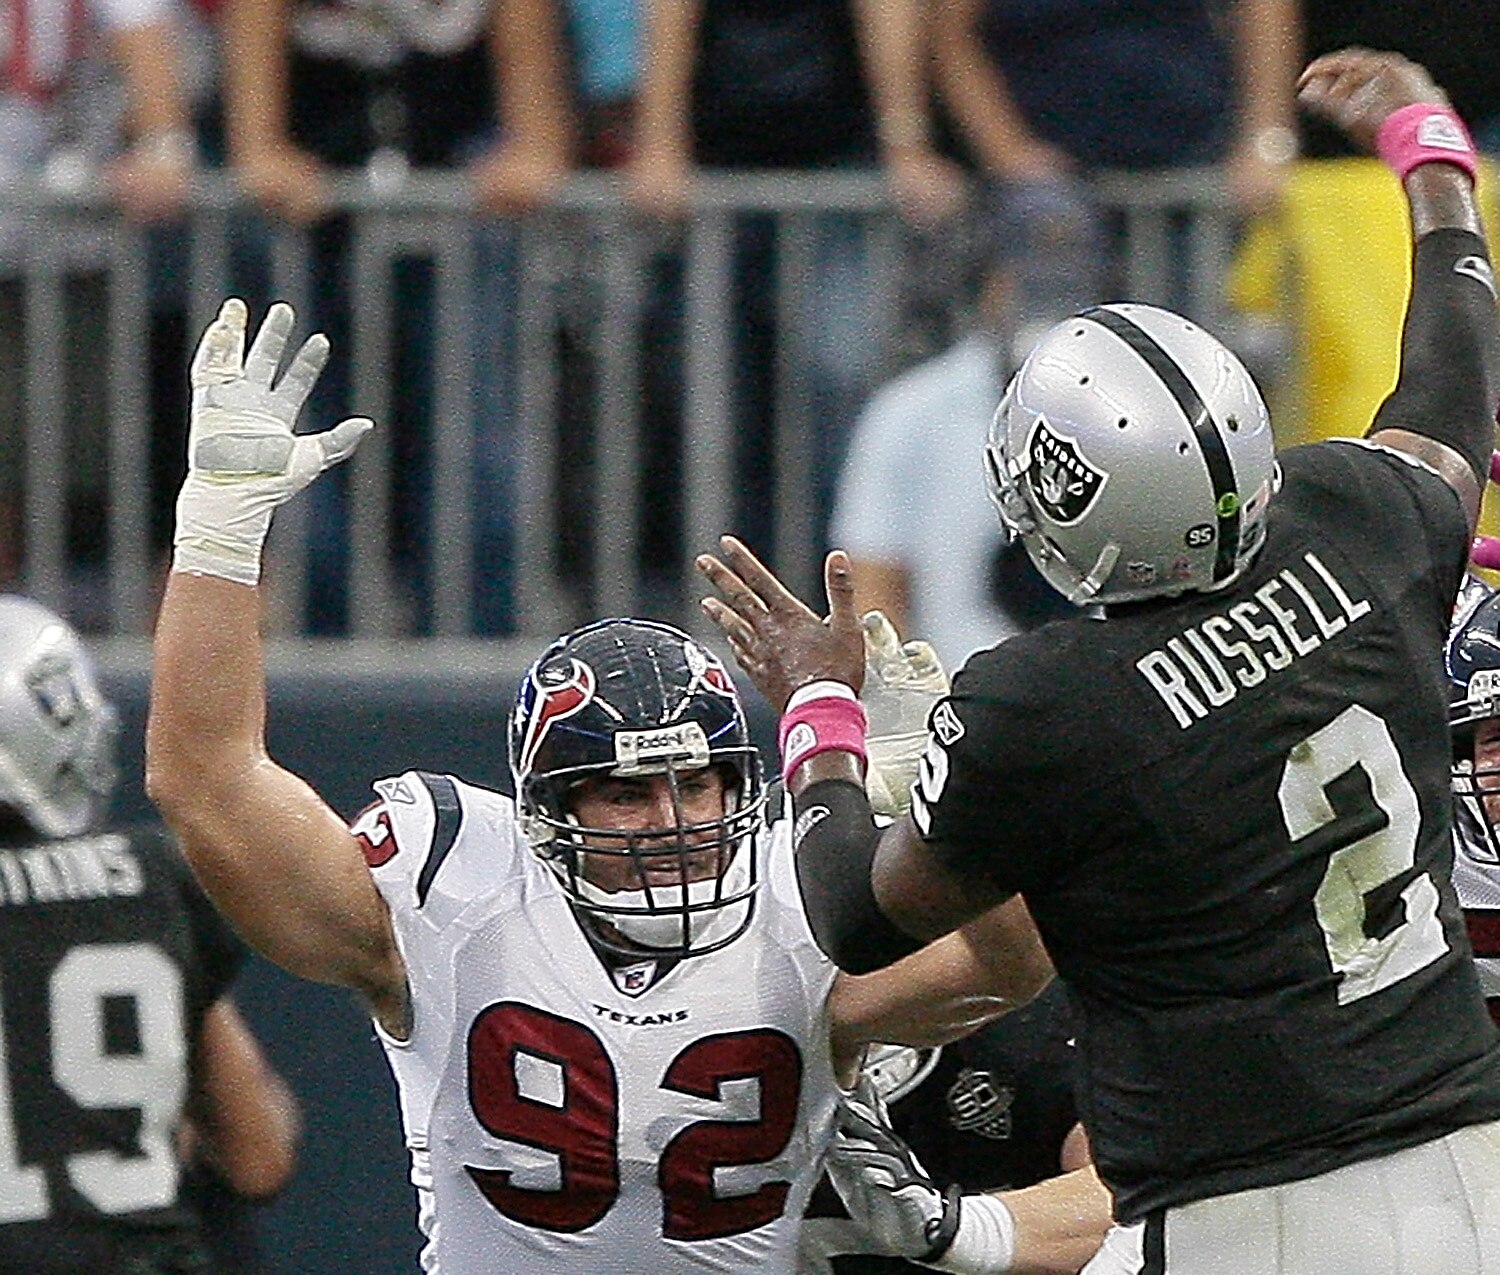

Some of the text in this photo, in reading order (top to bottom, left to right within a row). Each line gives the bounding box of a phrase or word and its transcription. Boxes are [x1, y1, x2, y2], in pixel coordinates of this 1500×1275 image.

[1040, 429, 1093, 483] RAIDERS
[1136, 552, 1372, 730] RUSSELL
[1277, 703, 1451, 1005] 2
[592, 1003, 690, 1026] TEXANS
[464, 1000, 803, 1243] 92
